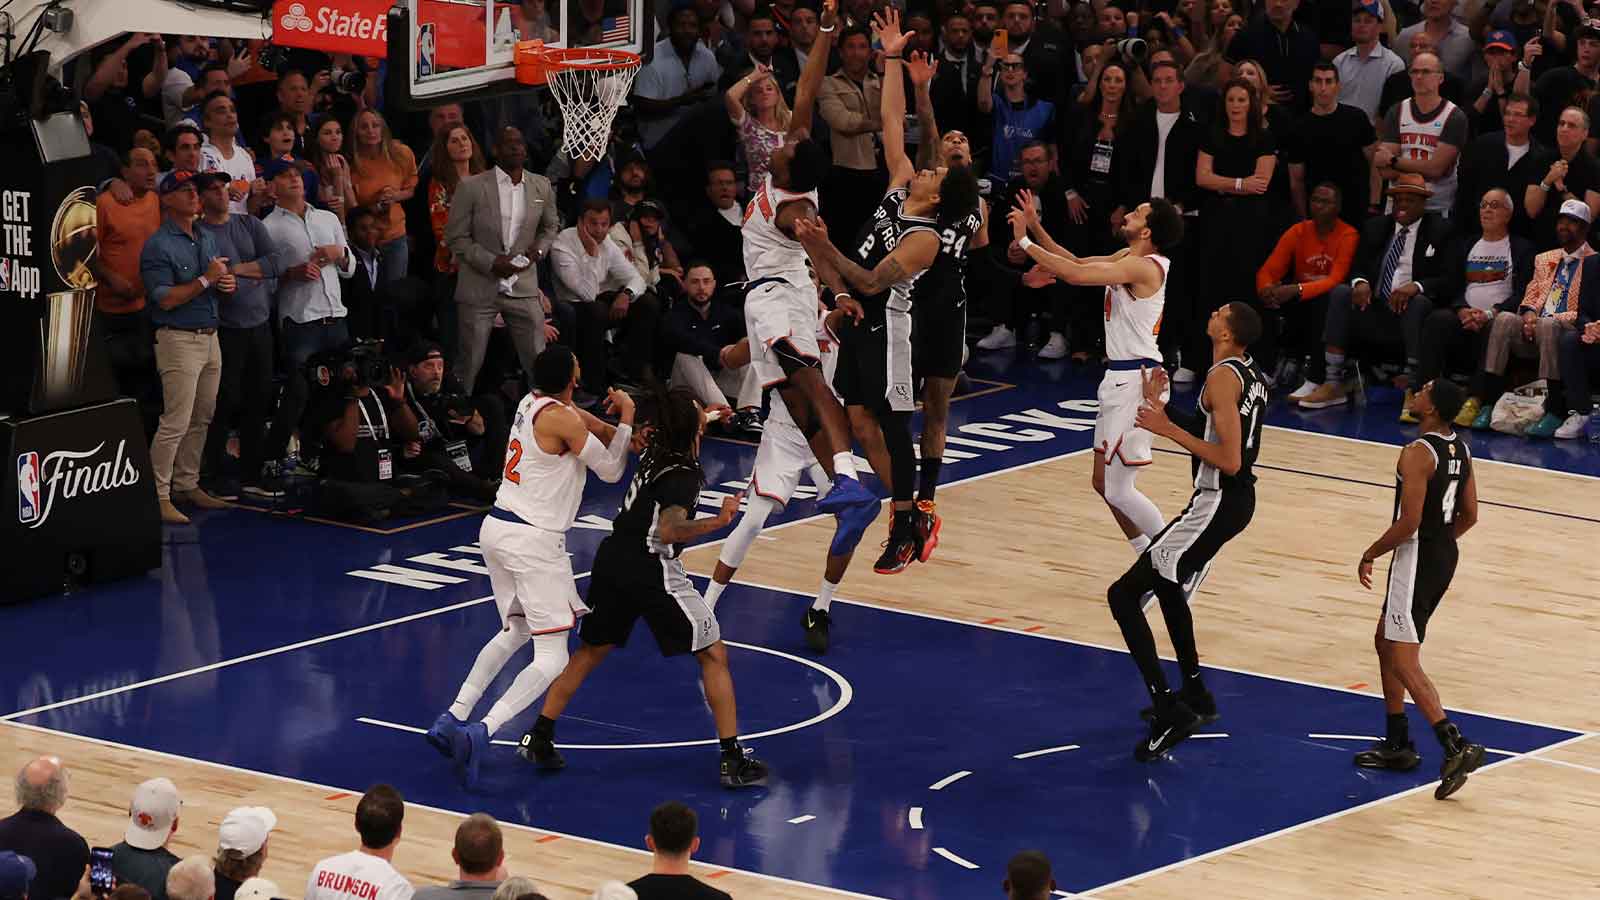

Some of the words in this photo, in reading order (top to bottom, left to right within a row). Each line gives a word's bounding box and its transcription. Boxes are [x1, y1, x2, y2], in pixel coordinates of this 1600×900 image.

[3, 190, 31, 222] GET
[3, 224, 33, 256] THE
[858, 233, 876, 259] 2
[942, 228, 967, 259] 24
[11, 259, 40, 299] App
[1246, 405, 1260, 449] 1
[29, 439, 140, 529] Finals
[1442, 480, 1459, 524] 4
[317, 870, 380, 900] BRUNSON
